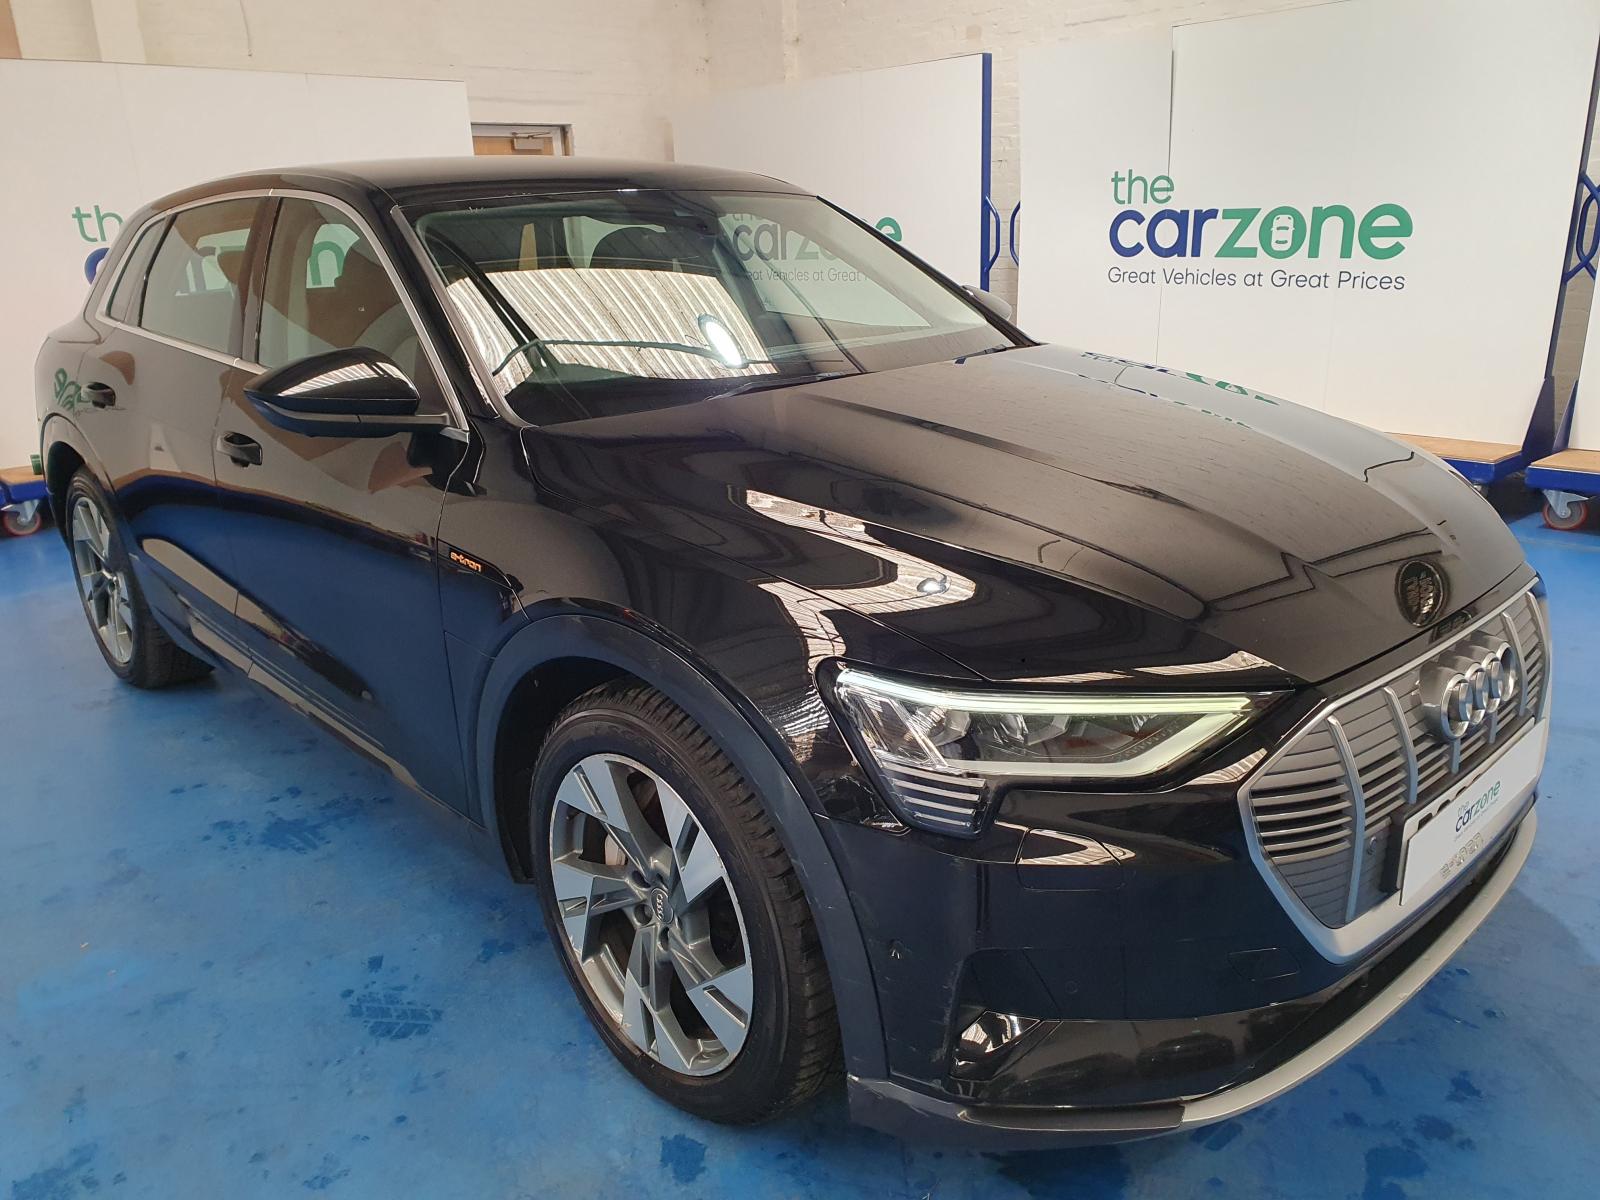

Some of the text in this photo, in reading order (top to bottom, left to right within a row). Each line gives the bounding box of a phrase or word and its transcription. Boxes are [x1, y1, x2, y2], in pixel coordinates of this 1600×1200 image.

[1111, 169, 1174, 205] the
[72, 205, 124, 242] th
[1109, 203, 1413, 260] carzone
[813, 270, 825, 281] at
[828, 268, 861, 282] Great
[1107, 266, 1406, 291] Great Vehicles at Great Prices
[1455, 781, 1501, 832] carzone
